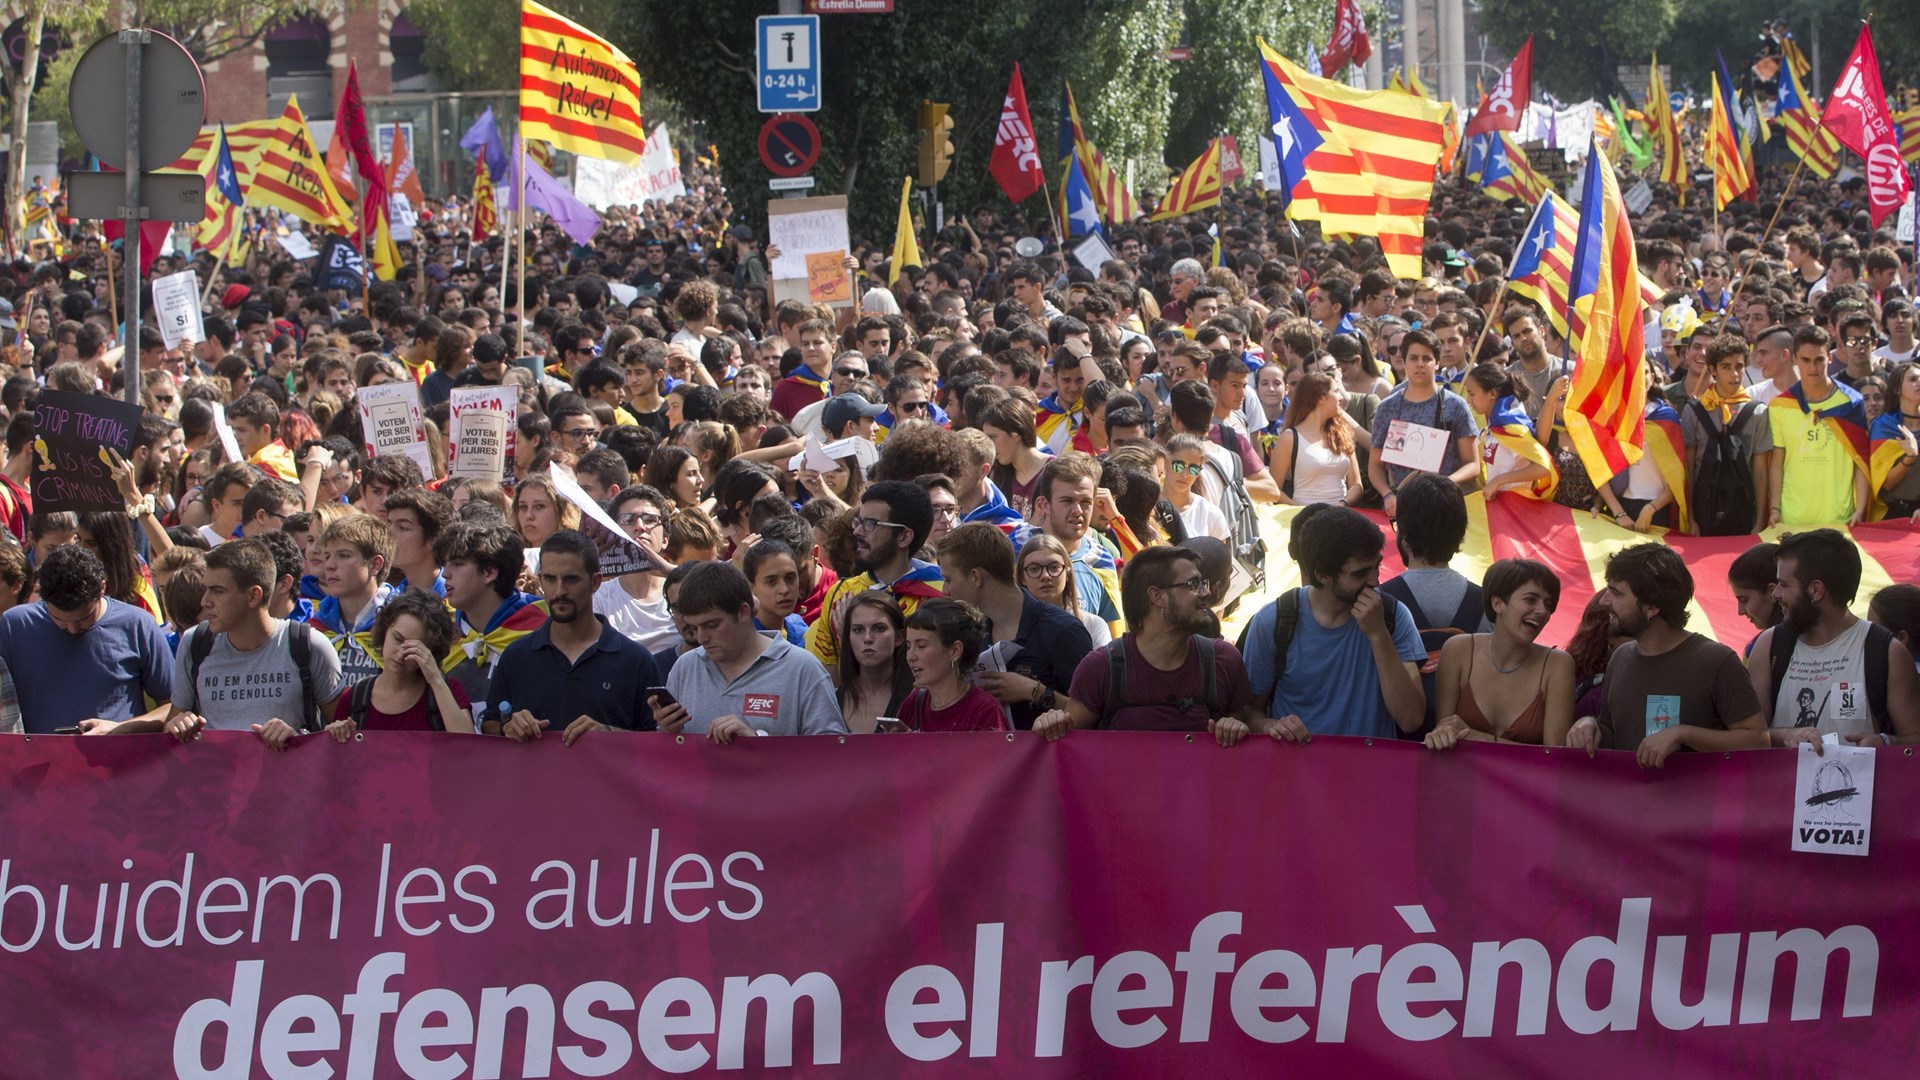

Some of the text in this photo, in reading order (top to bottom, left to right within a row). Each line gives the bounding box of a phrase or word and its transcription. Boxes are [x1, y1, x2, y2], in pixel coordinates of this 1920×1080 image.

[818, 0, 885, 9] Estrella Damm
[765, 74, 806, 88] 0-24 h
[557, 81, 615, 121] Rebel
[1872, 117, 1889, 137] DE
[33, 404, 129, 451] STOP TREATING
[378, 417, 406, 428] VOTEM
[377, 426, 411, 438] PER SER
[465, 428, 497, 438] VOTEM
[378, 435, 412, 447] LLIURES
[461, 438, 478, 446] PER
[480, 437, 499, 447] SER
[461, 446, 498, 456] LLIURES
[56, 449, 103, 478] US AS
[204, 671, 291, 688] NO EM POSARÉ
[211, 687, 282, 701] DE GENOLLS
[1833, 820, 1861, 828] impediran
[1799, 828, 1865, 846] VOTA!
[0, 829, 764, 952] buidem les aules
[173, 898, 1879, 1080] defensem el referèndum
